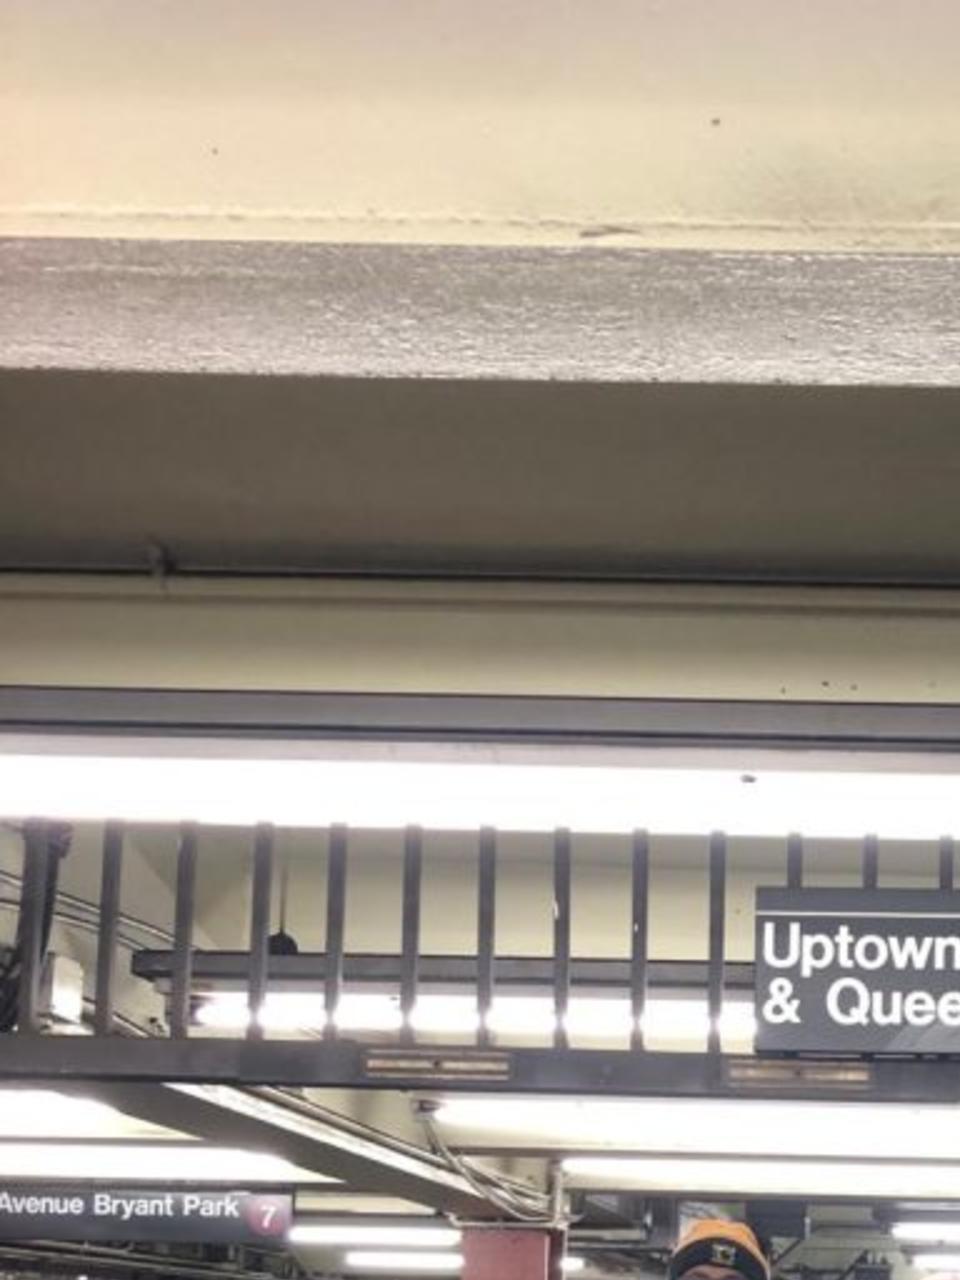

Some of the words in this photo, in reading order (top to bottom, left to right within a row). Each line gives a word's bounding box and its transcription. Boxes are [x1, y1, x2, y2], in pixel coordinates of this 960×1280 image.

[762, 977, 800, 1024] &
[0, 1192, 84, 1214] Avenue
[93, 1194, 174, 1220] Bryant
[182, 1196, 240, 1218] Park
[259, 1204, 276, 1229] 7
